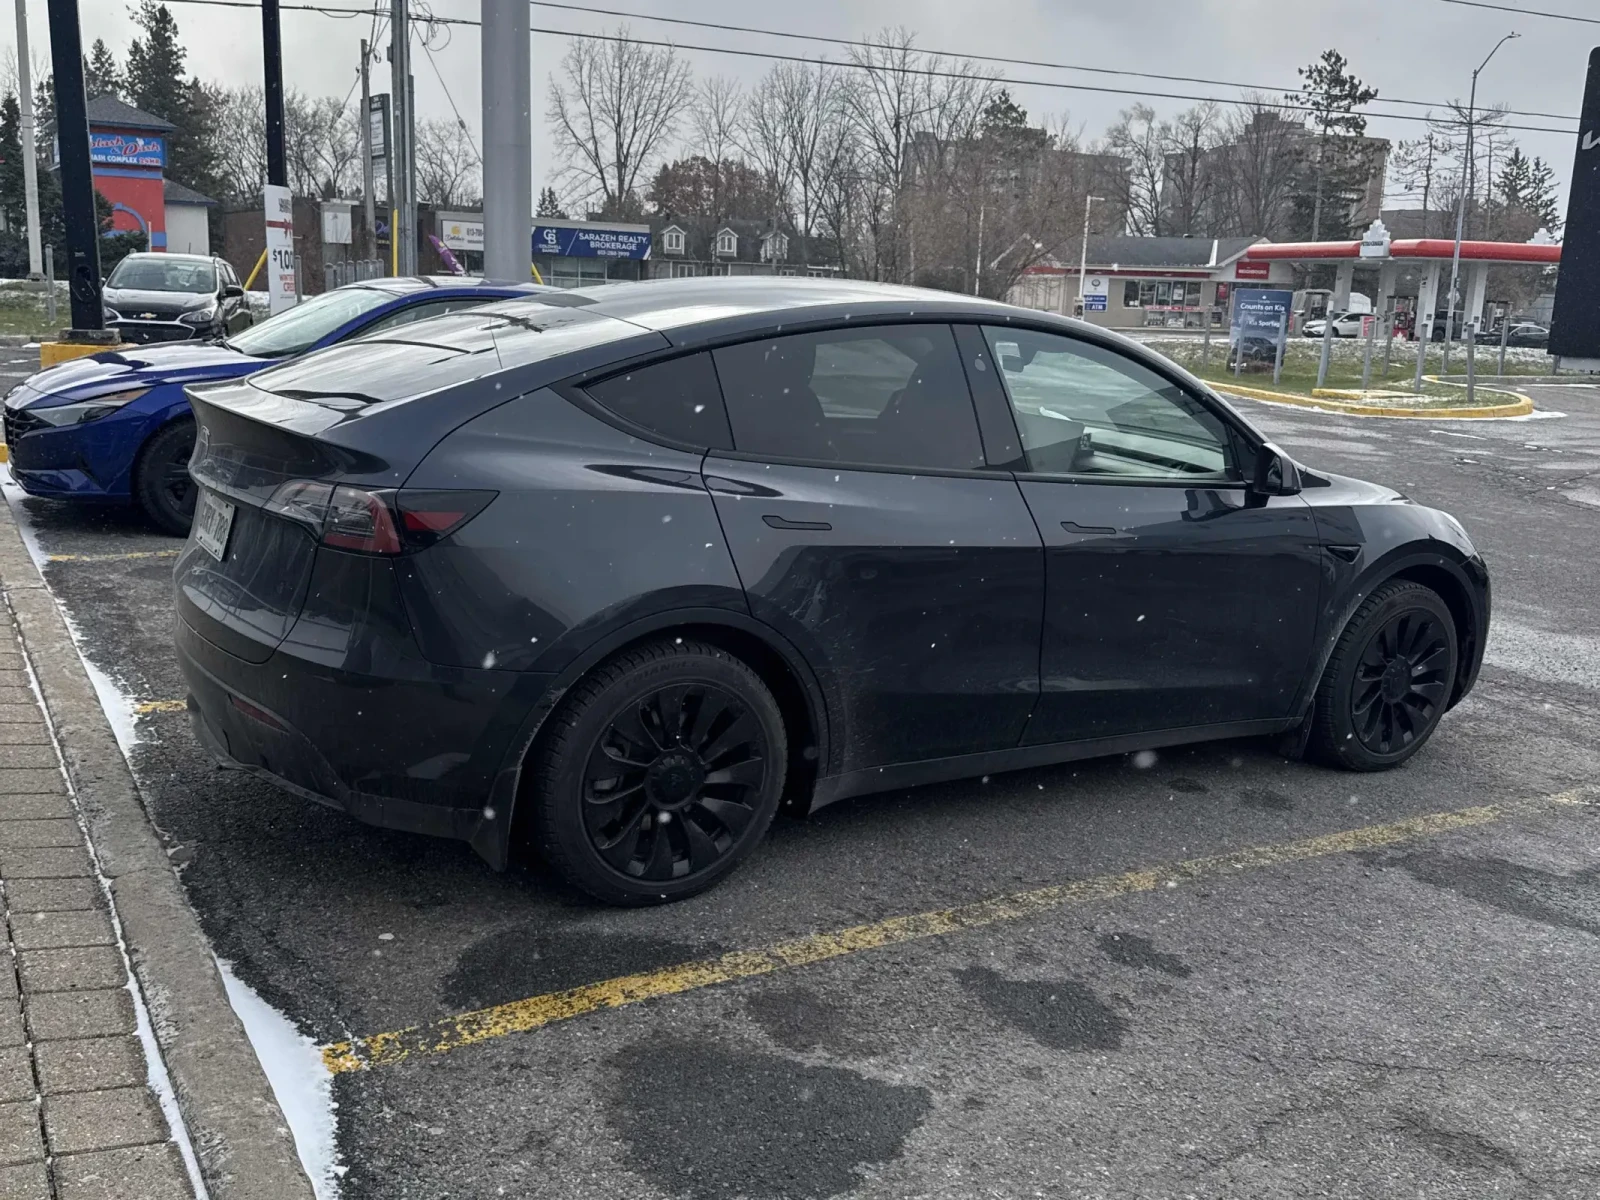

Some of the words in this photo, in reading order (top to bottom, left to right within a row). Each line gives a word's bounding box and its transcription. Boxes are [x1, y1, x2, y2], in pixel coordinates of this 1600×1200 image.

[122, 141, 160, 156] Dash
[107, 155, 138, 163] COMPLEX
[578, 232, 616, 242] SARAZEN
[589, 241, 638, 250] BROKERAGE
[1240, 302, 1264, 310] Counts
